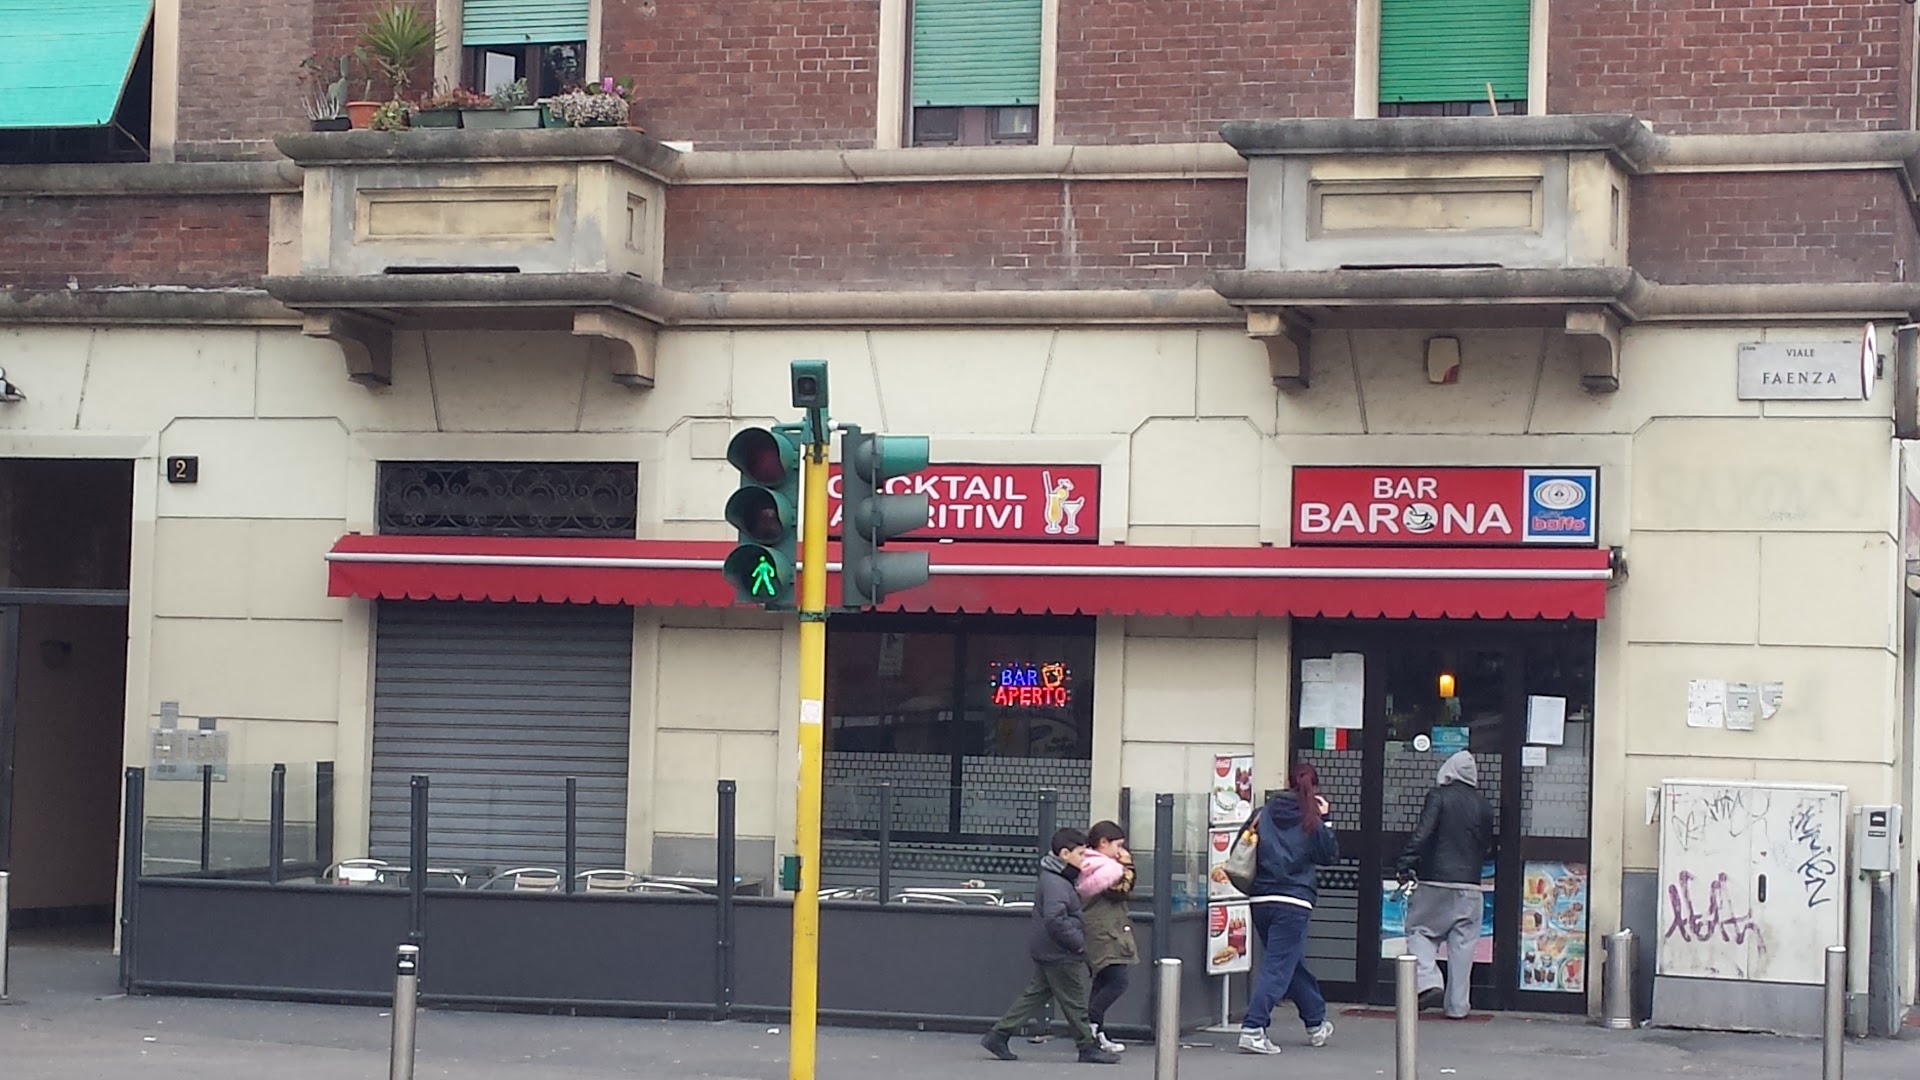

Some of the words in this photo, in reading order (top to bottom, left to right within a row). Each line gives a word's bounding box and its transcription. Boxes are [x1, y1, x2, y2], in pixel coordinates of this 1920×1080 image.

[1786, 348, 1815, 358] VIALE
[1762, 371, 1837, 385] FAENZA
[175, 459, 187, 479] 2
[827, 474, 1028, 501] CCKTAIL
[1373, 477, 1438, 499] BAR
[1300, 502, 1513, 535] BARONA
[1001, 669, 1038, 686] BAR
[995, 685, 1067, 706] APERTO
